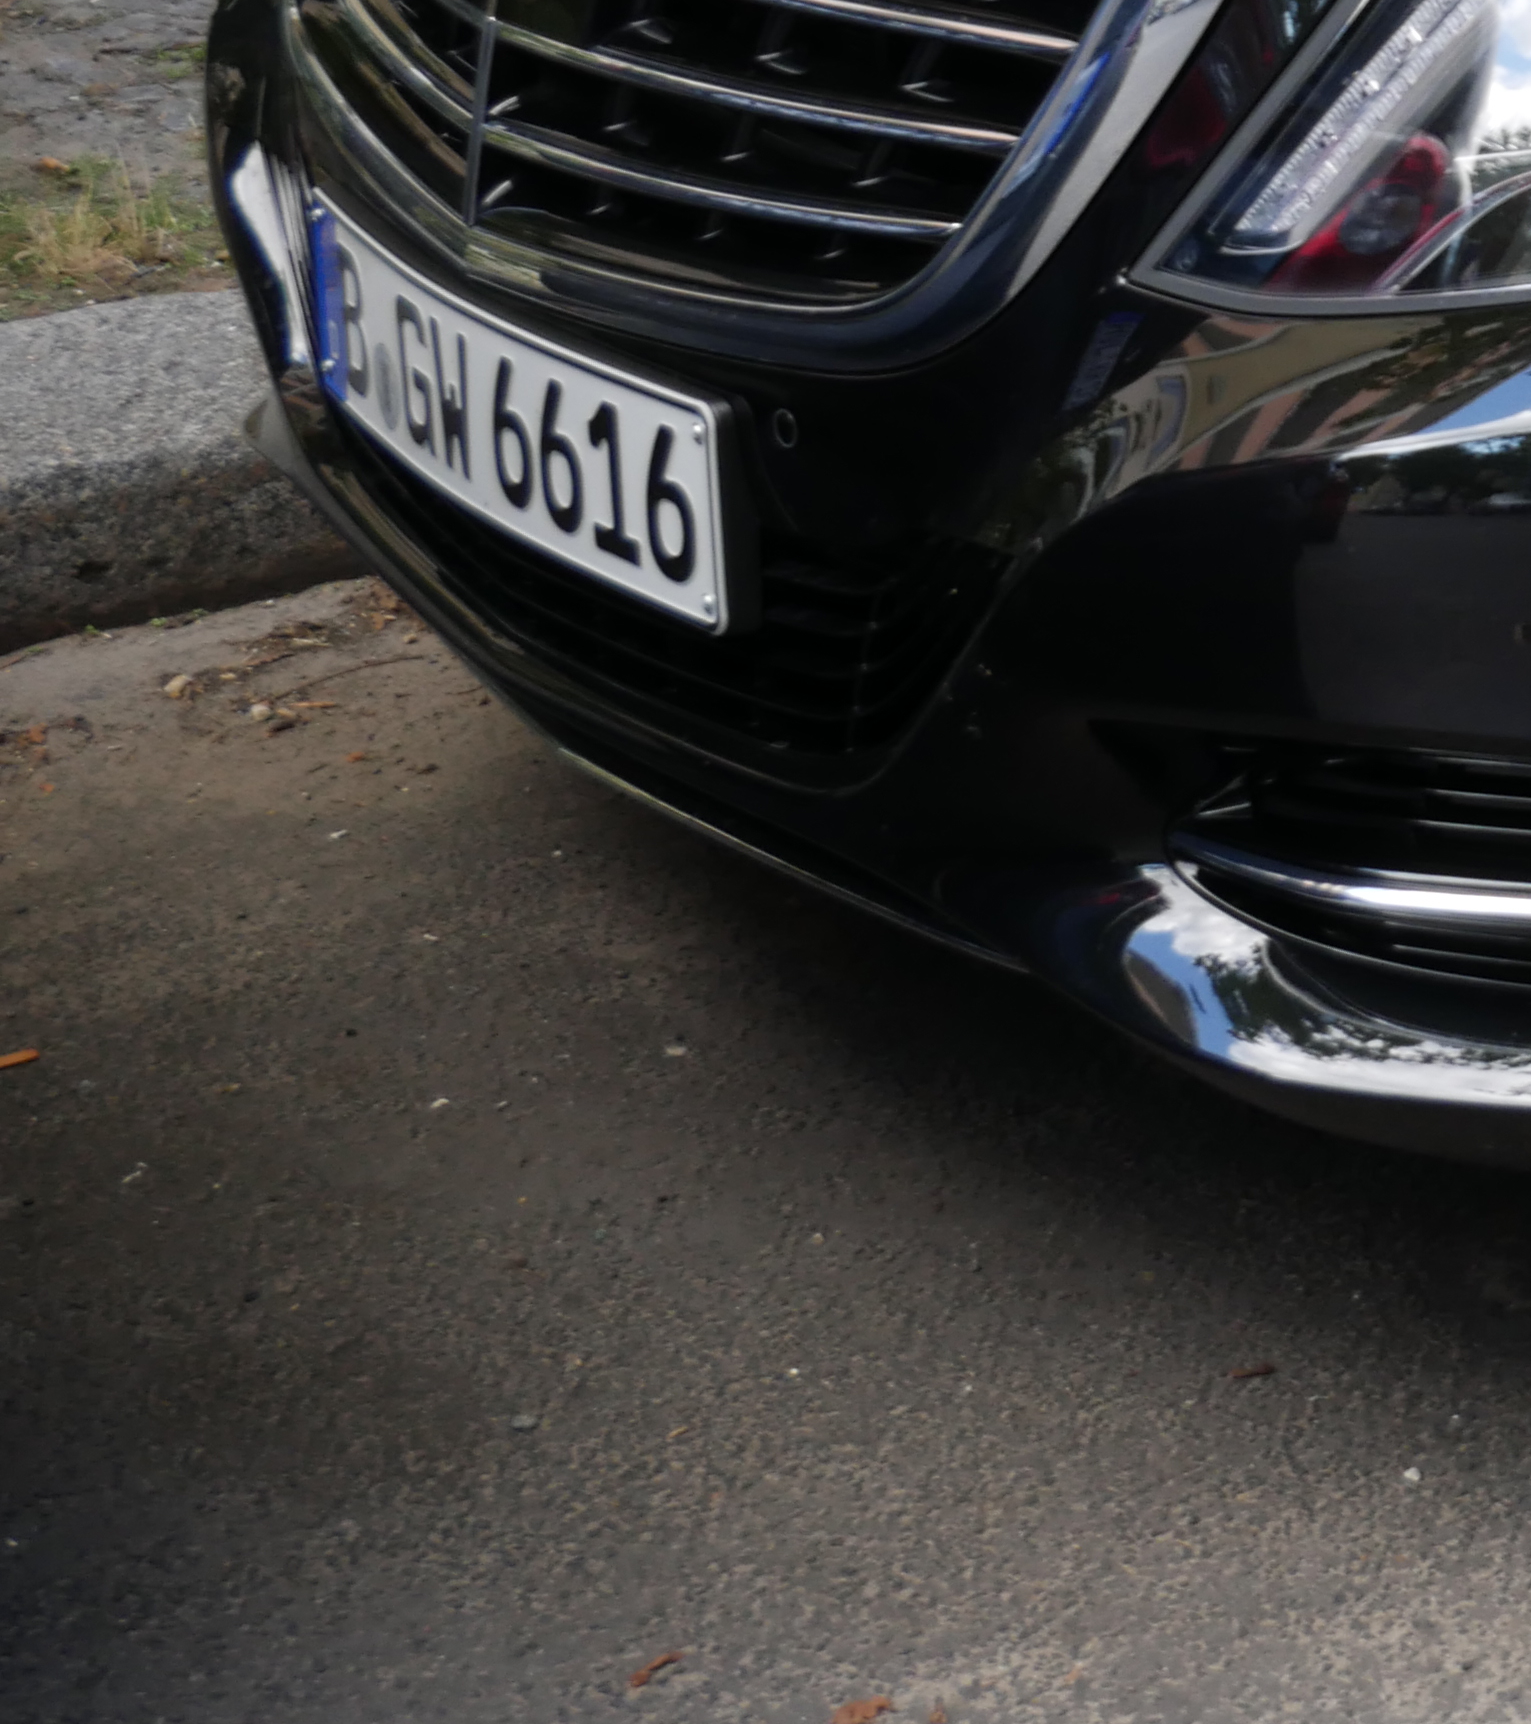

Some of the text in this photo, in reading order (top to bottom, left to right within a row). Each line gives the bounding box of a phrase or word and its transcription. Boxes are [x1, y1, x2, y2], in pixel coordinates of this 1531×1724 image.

[338, 241, 696, 583] B GW 6616
